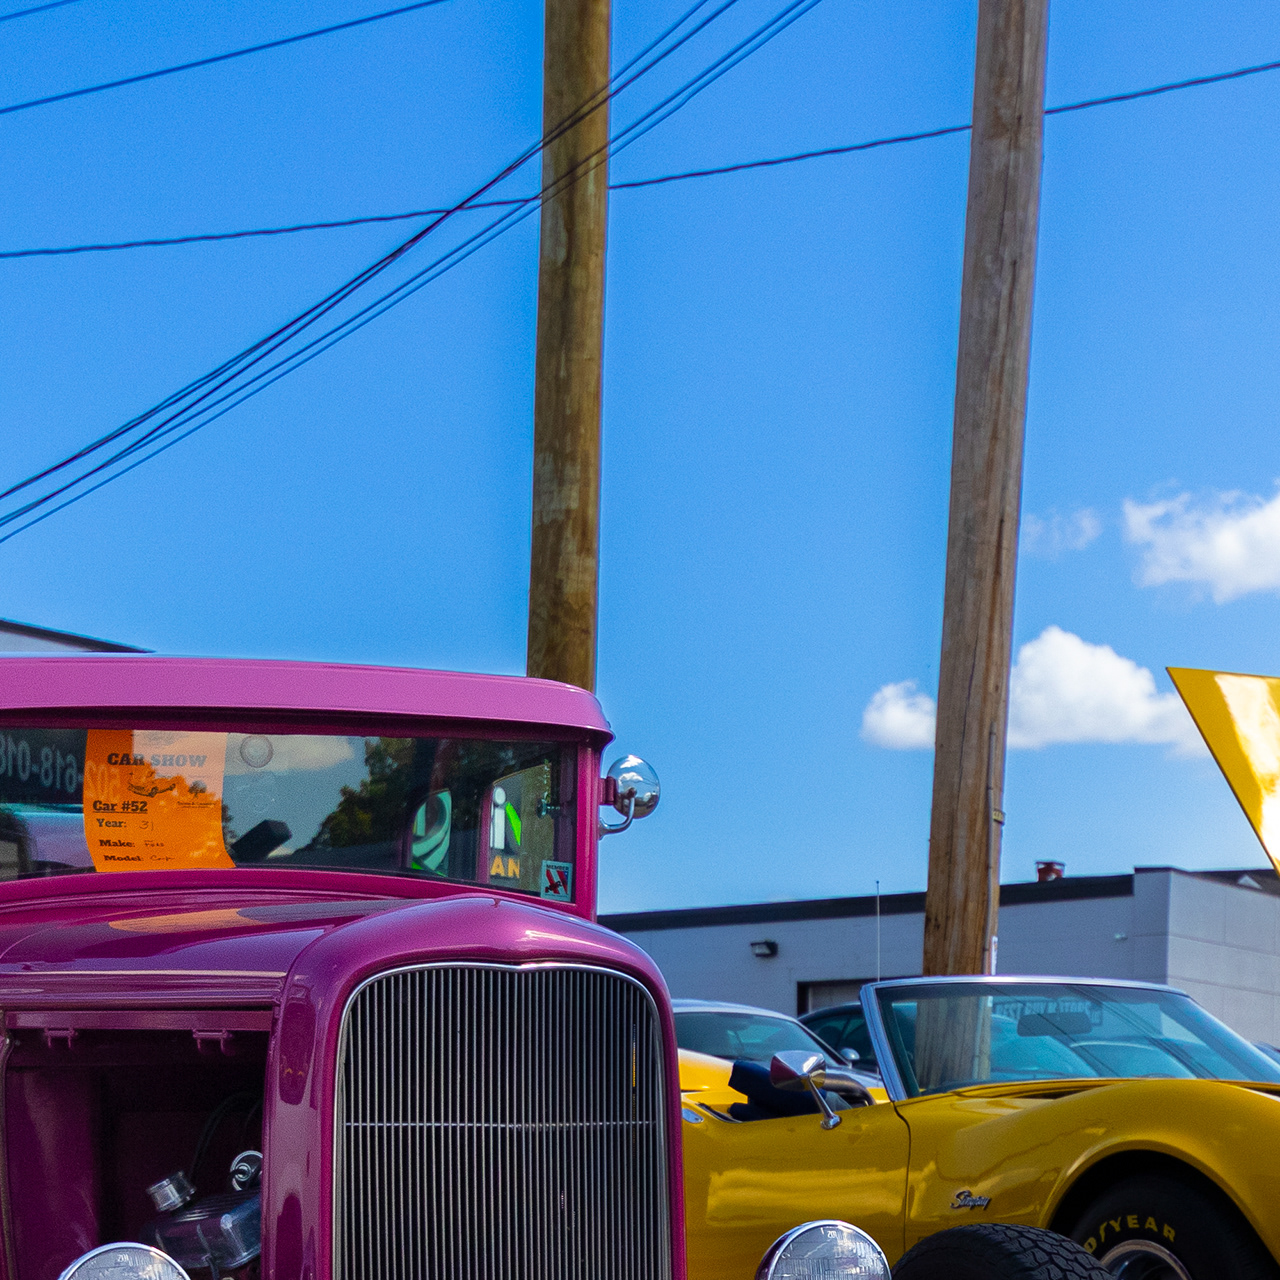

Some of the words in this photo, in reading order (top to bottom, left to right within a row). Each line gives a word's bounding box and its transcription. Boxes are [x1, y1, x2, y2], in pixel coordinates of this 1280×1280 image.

[107, 753, 144, 766] CAR
[150, 754, 208, 767] SHOW
[93, 800, 118, 812] Car
[122, 800, 148, 812] #52
[96, 818, 127, 828] Year:
[99, 839, 135, 848] Make:
[104, 854, 144, 862] Model:
